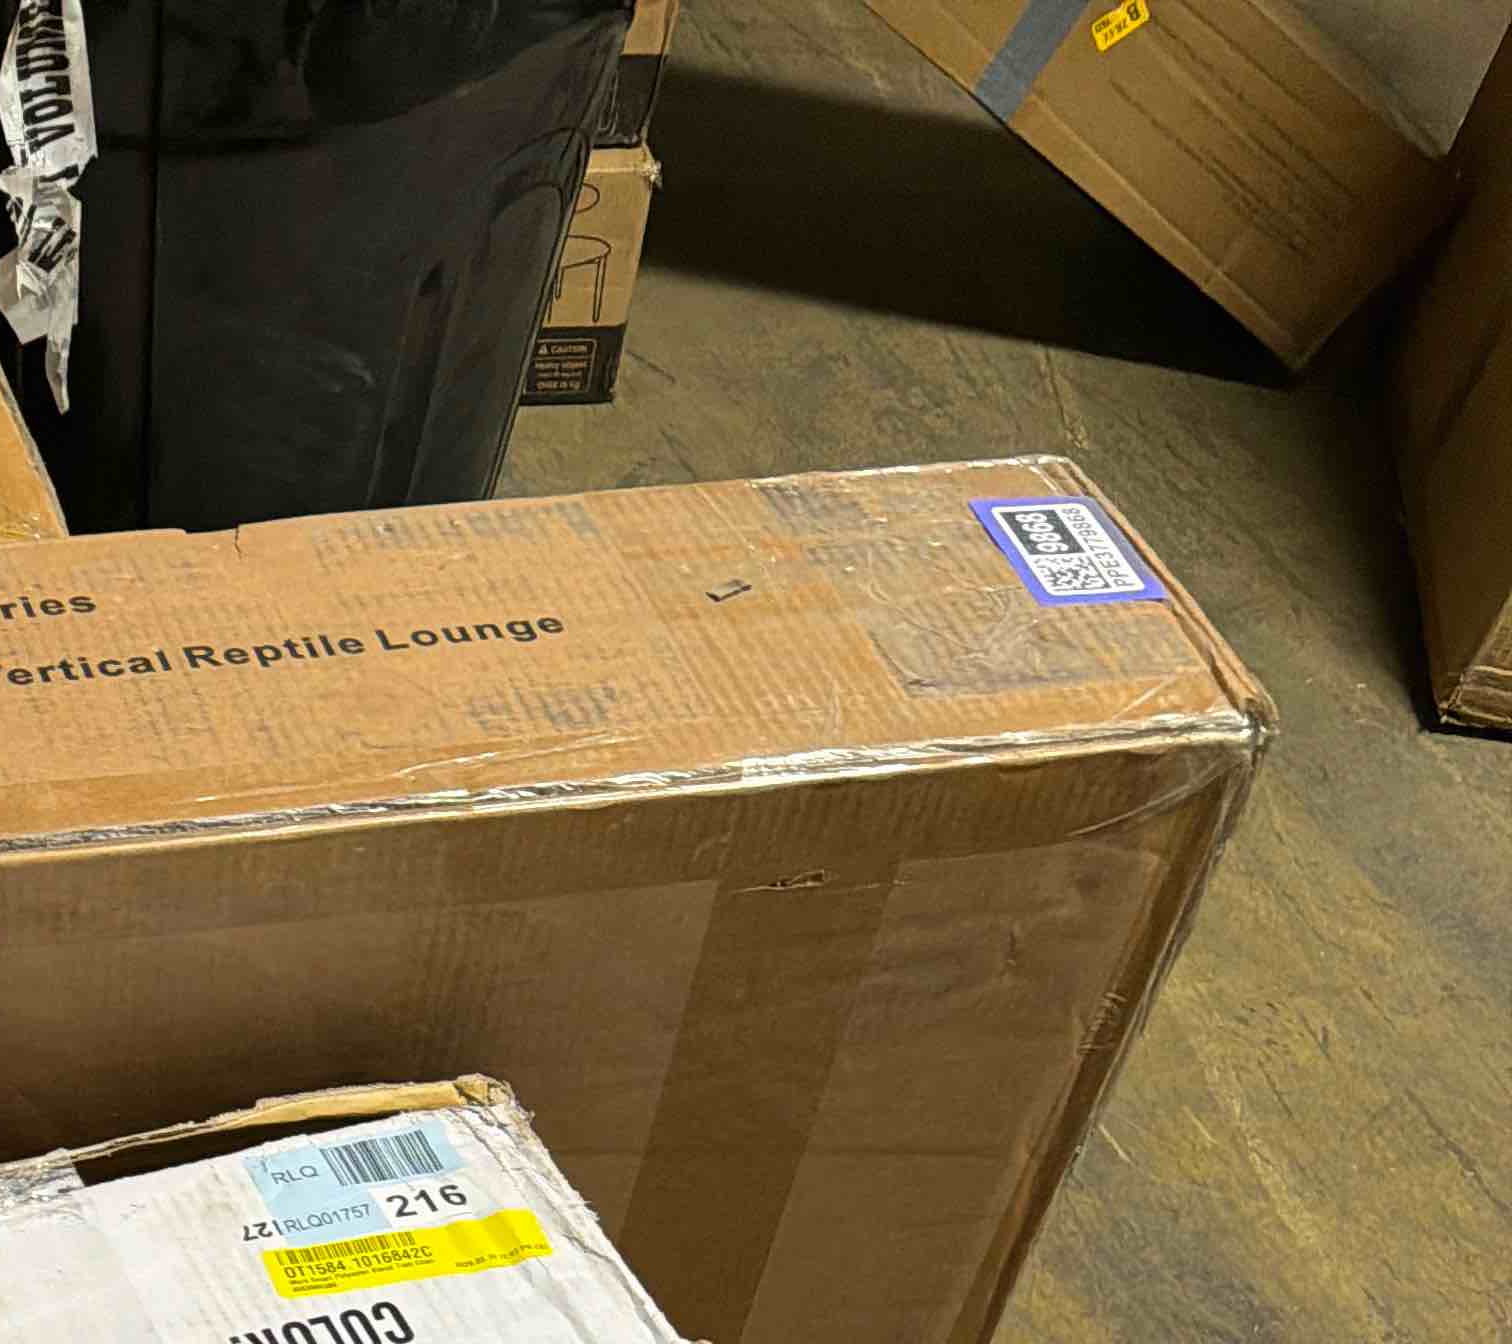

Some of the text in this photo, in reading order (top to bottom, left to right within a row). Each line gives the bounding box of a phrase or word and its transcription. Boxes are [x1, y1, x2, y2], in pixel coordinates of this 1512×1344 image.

[1015, 513, 1070, 552] 9868
[1061, 508, 1134, 587] PPE3779868
[185, 633, 365, 671] Reptile
[376, 612, 563, 652] Lounge
[270, 1164, 319, 1185] RLQ
[283, 1203, 371, 1234] RLQ01757
[386, 1183, 468, 1218] 216
